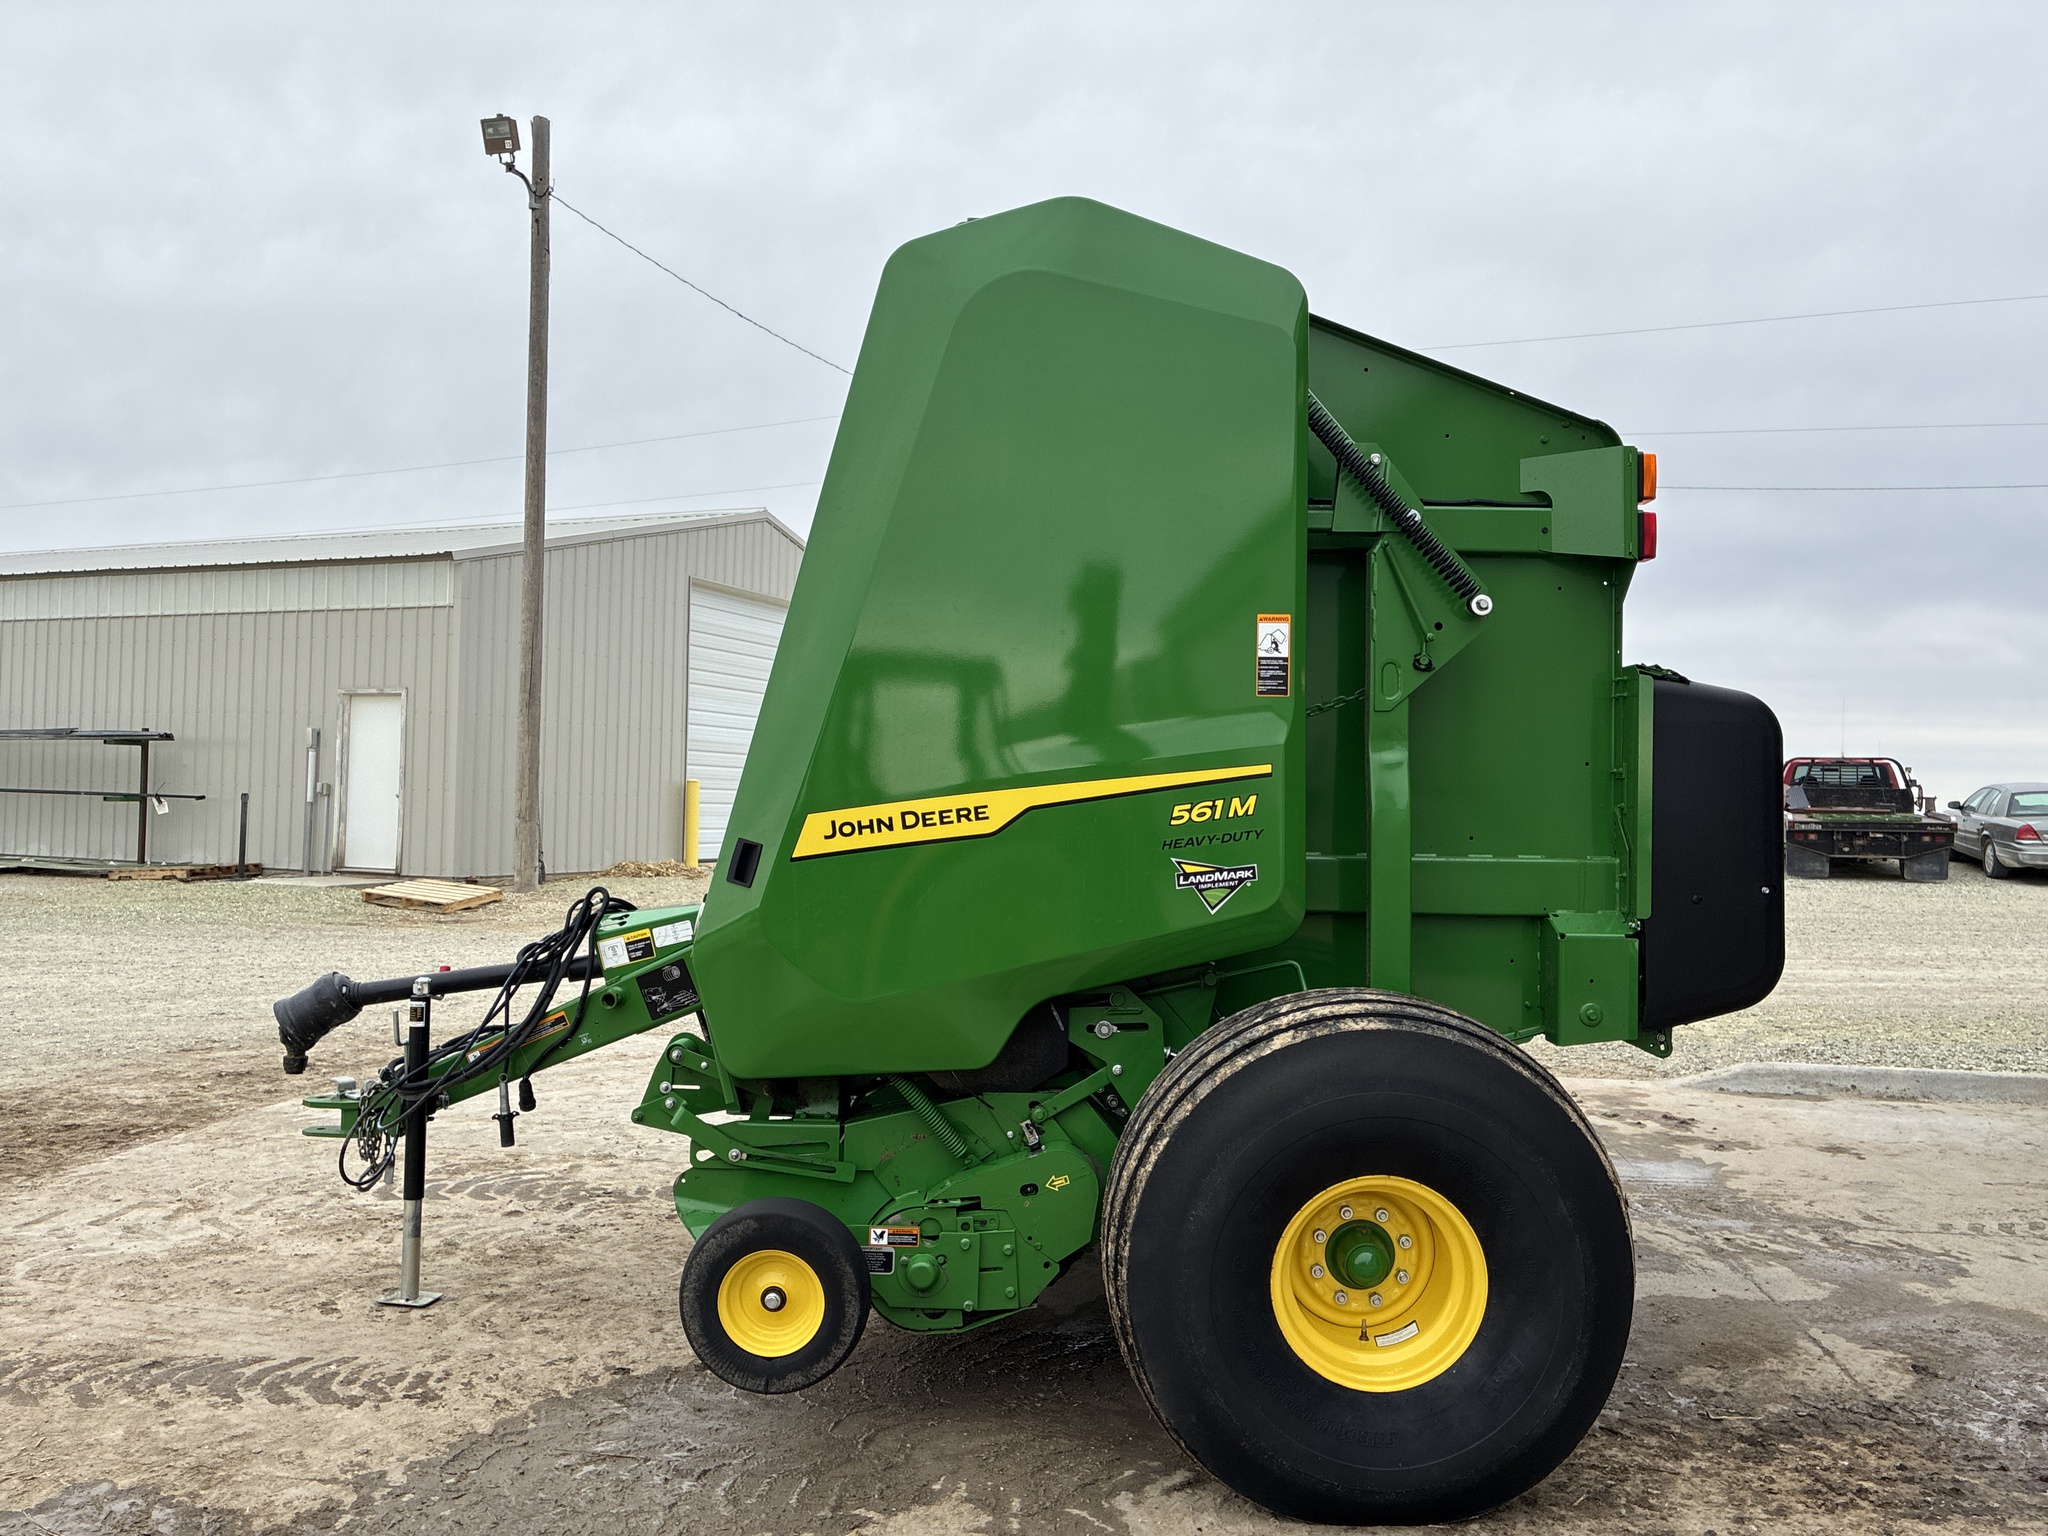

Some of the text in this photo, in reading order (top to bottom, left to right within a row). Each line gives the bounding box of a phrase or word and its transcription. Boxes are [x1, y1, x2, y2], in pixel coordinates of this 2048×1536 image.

[1169, 793, 1258, 826] 561 M
[1161, 828, 1264, 850] HEAVY-DUTY
[1198, 880, 1239, 889] IMPLEMENT
[630, 932, 648, 940] CAUTION
